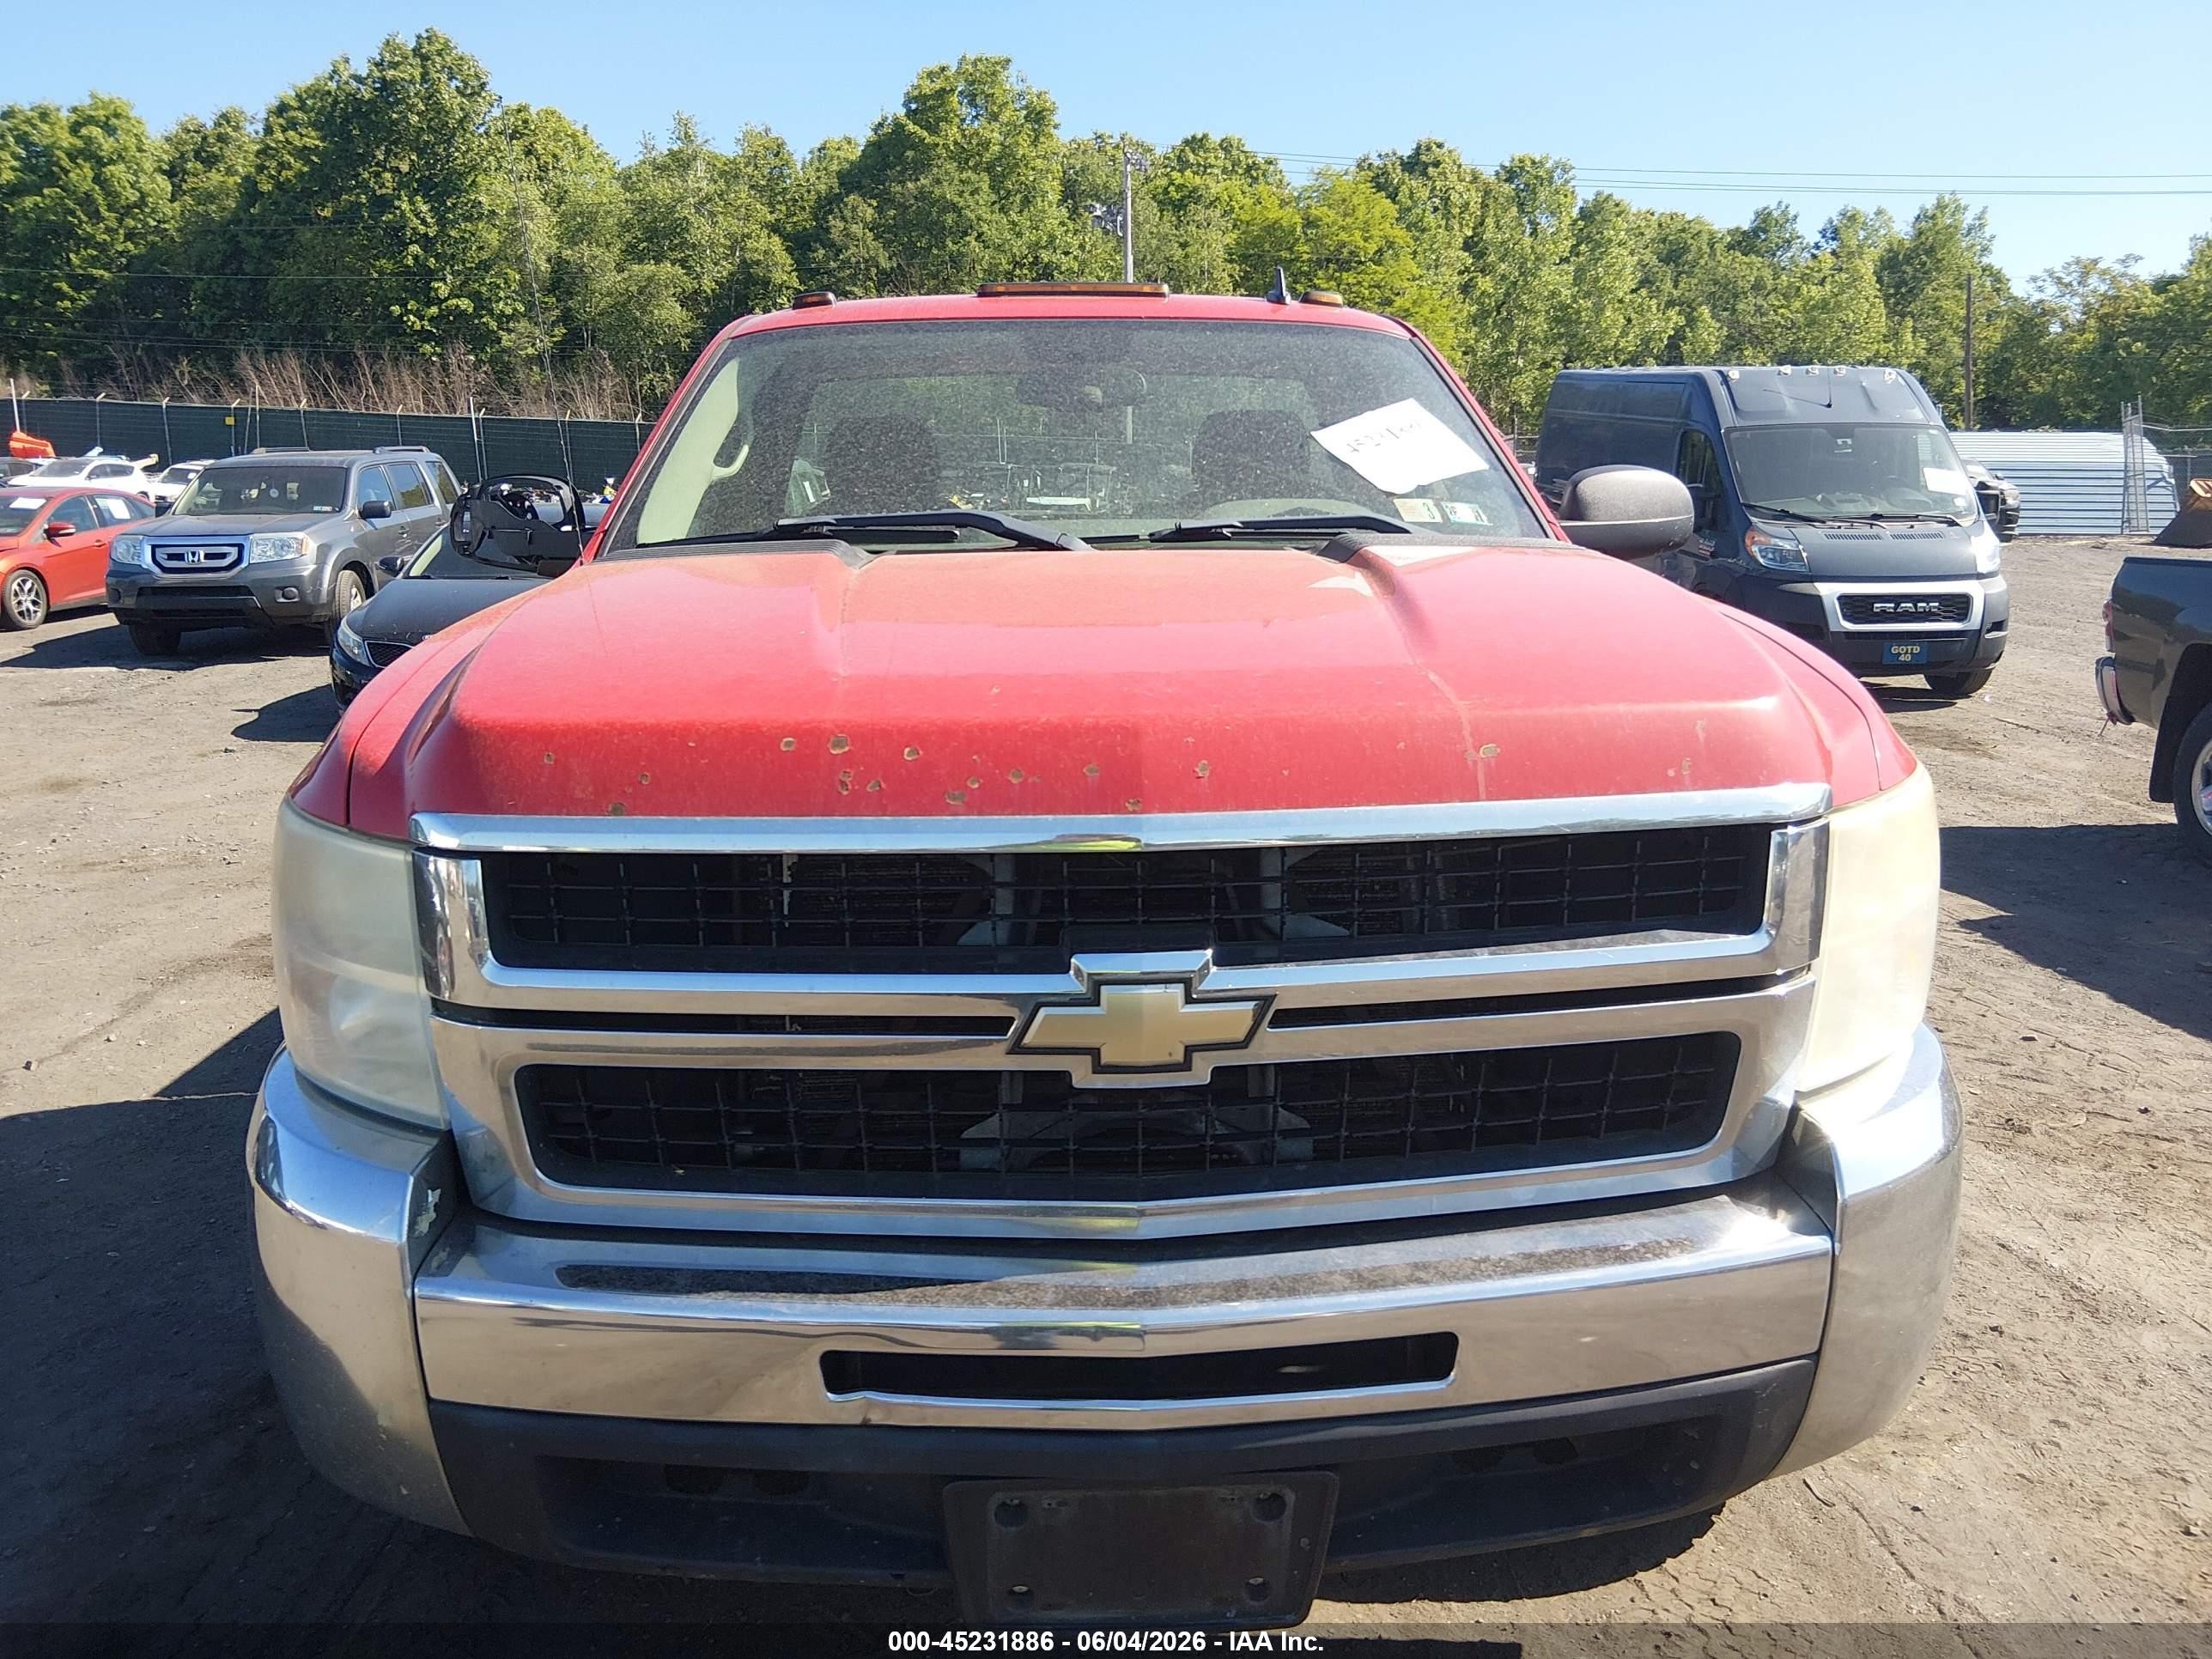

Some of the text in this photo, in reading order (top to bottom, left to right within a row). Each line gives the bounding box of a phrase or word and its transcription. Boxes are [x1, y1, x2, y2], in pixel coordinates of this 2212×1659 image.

[1873, 602, 1940, 612] RAM
[1891, 645, 1921, 653] GOTD
[1898, 653, 1911, 662] 40
